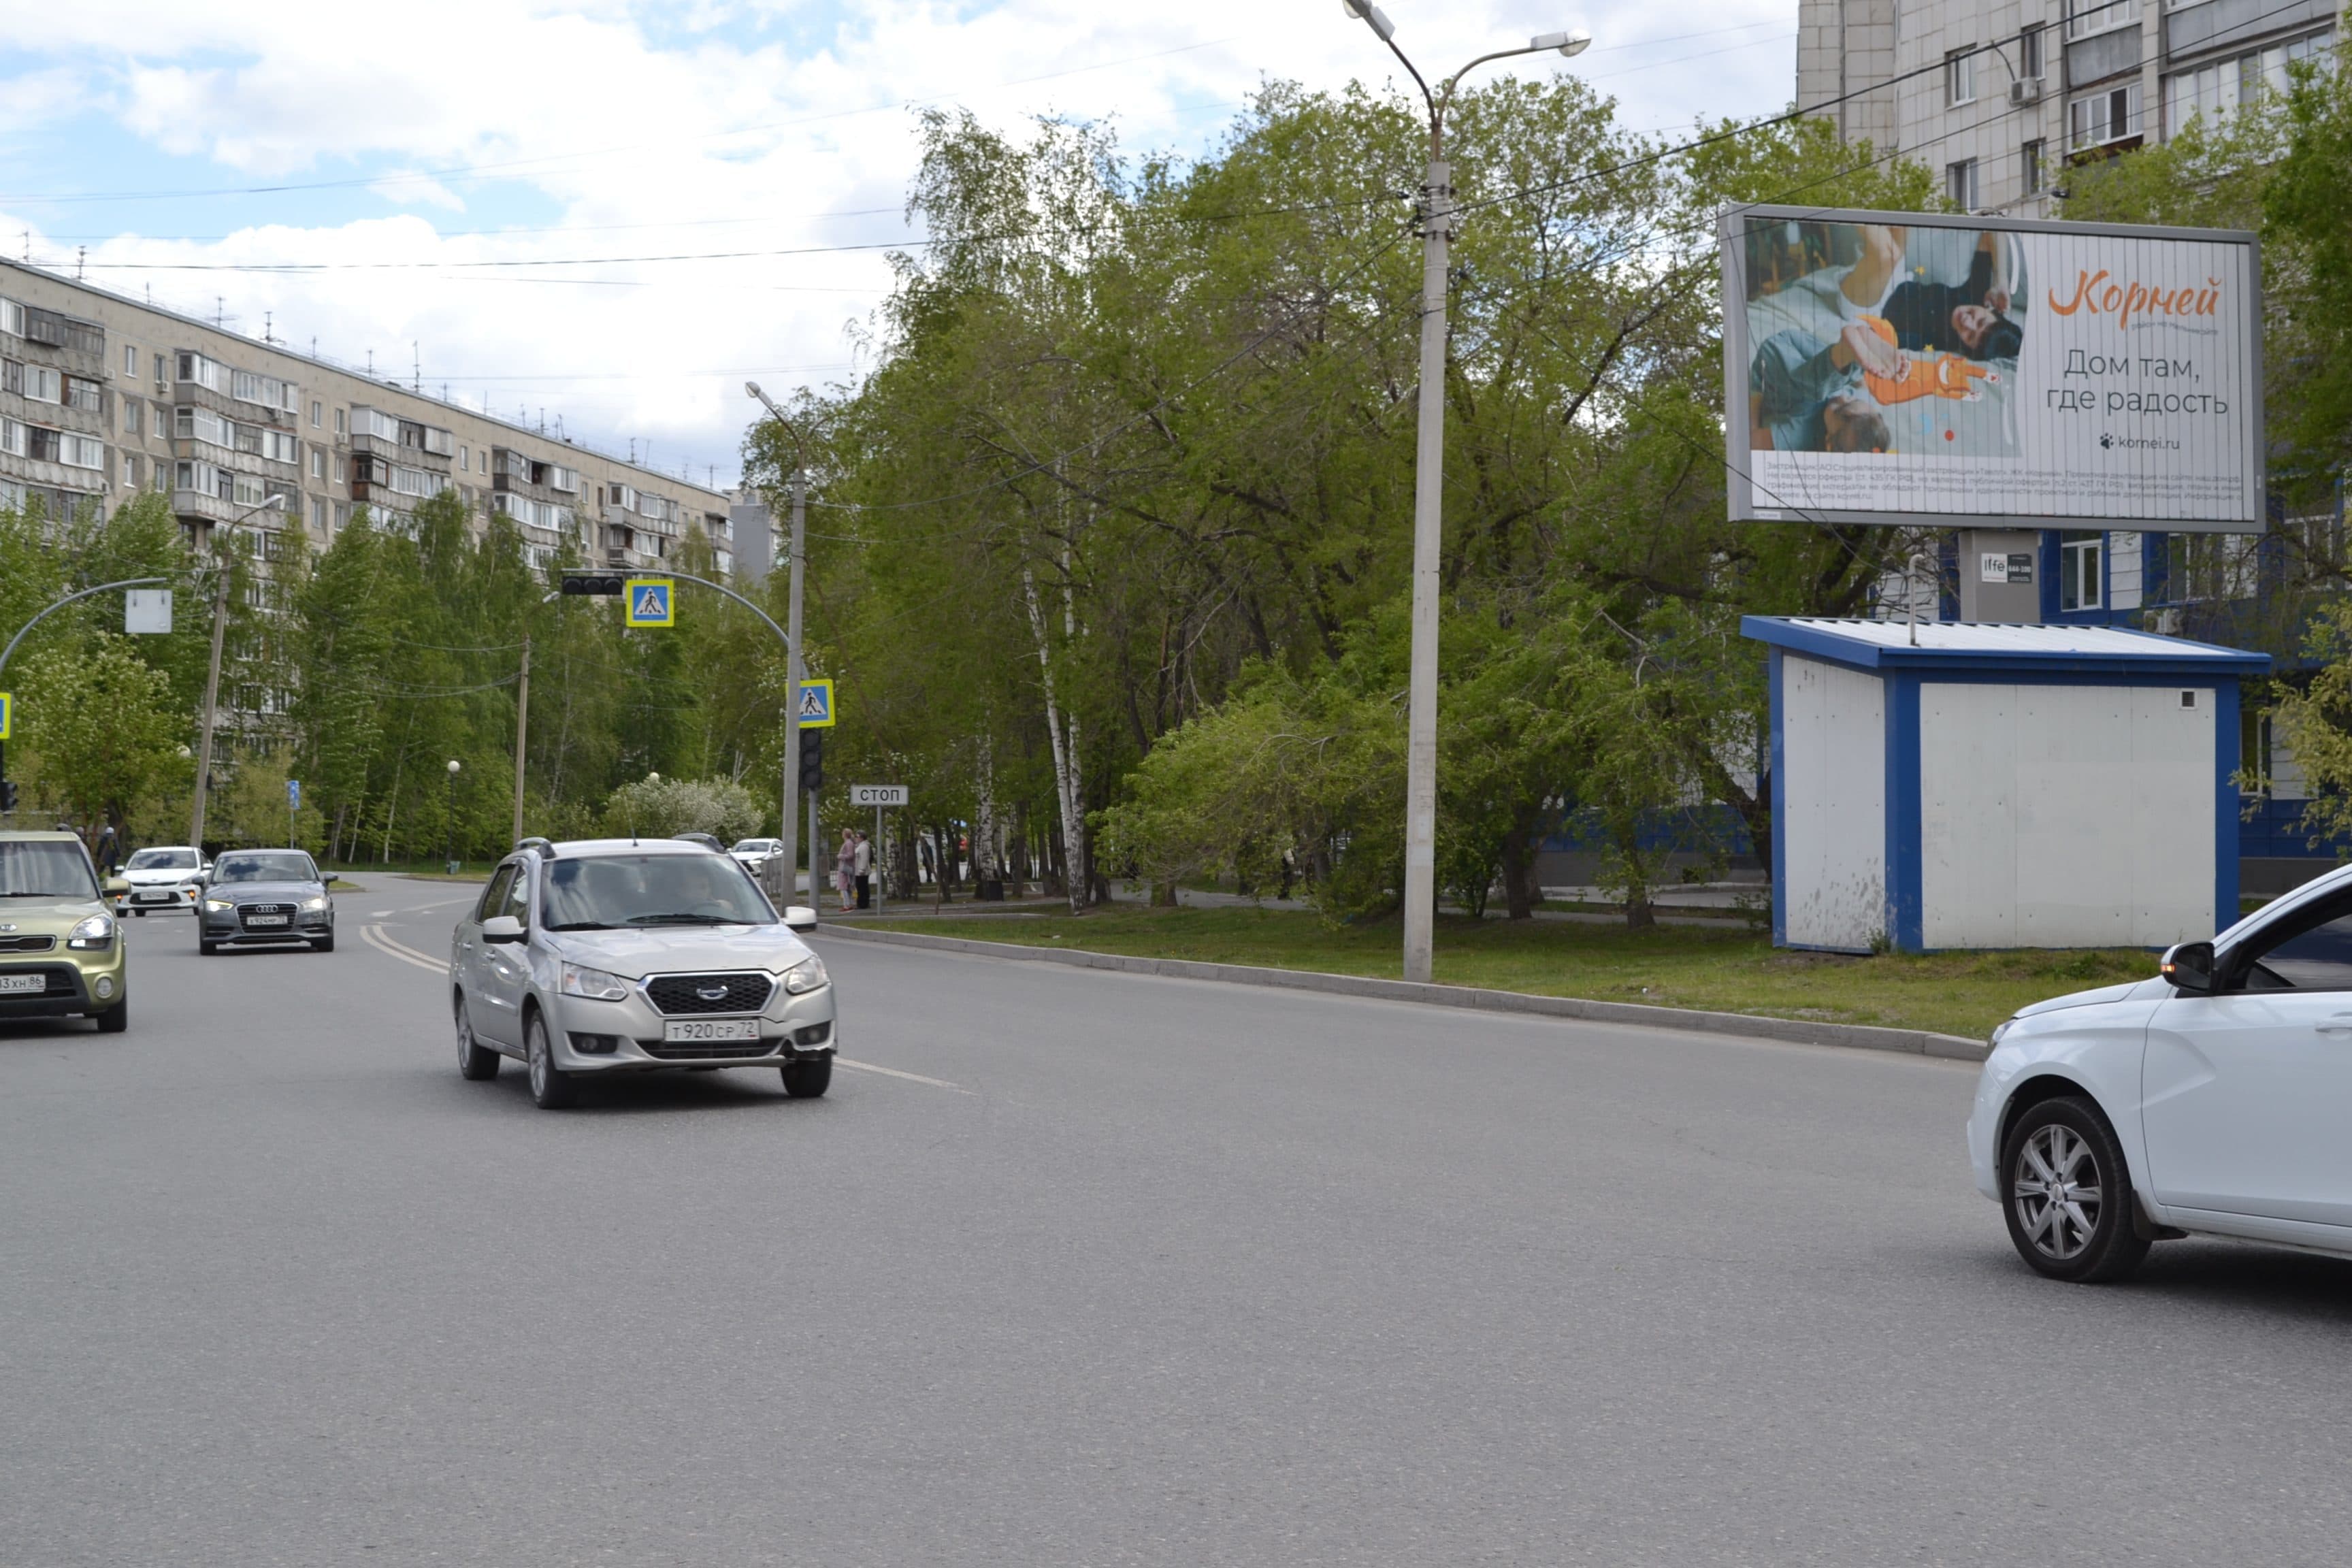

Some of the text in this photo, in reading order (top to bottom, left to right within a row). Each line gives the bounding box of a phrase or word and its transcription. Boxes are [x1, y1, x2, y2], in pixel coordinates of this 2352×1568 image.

[2048, 269, 2222, 331] Корней
[2064, 349, 2200, 383] Дом там,
[2047, 389, 2228, 416] где радость
[2119, 435, 2180, 450] kornei.ru
[860, 789, 900, 802] СТОП
[29, 976, 42, 985] 86
